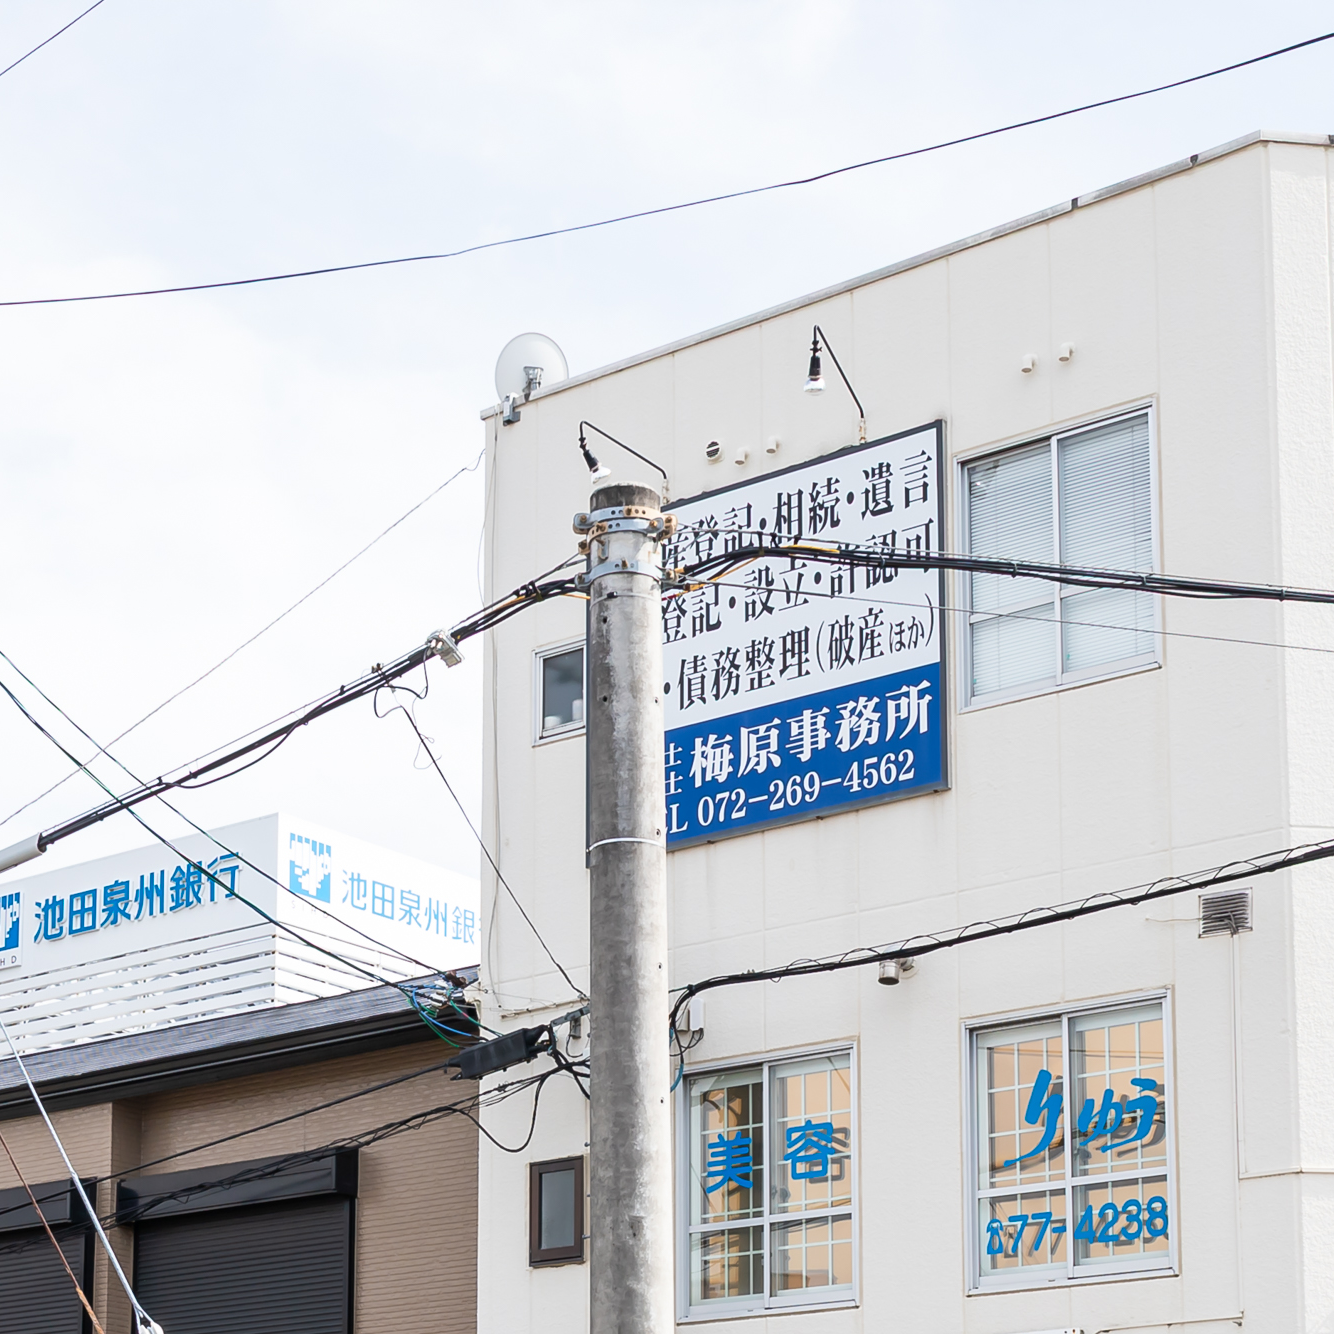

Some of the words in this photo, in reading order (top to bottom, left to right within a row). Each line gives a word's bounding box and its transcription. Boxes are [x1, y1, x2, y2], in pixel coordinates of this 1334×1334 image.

[689, 679, 933, 788] 梅原事務所
[697, 748, 916, 827] 072-269-4562
[33, 850, 245, 945] 池田泉州銀行
[341, 869, 481, 945] 池田泉州銀
[705, 1119, 835, 1194] 美容
[1007, 1195, 1169, 1253] 77-4238
